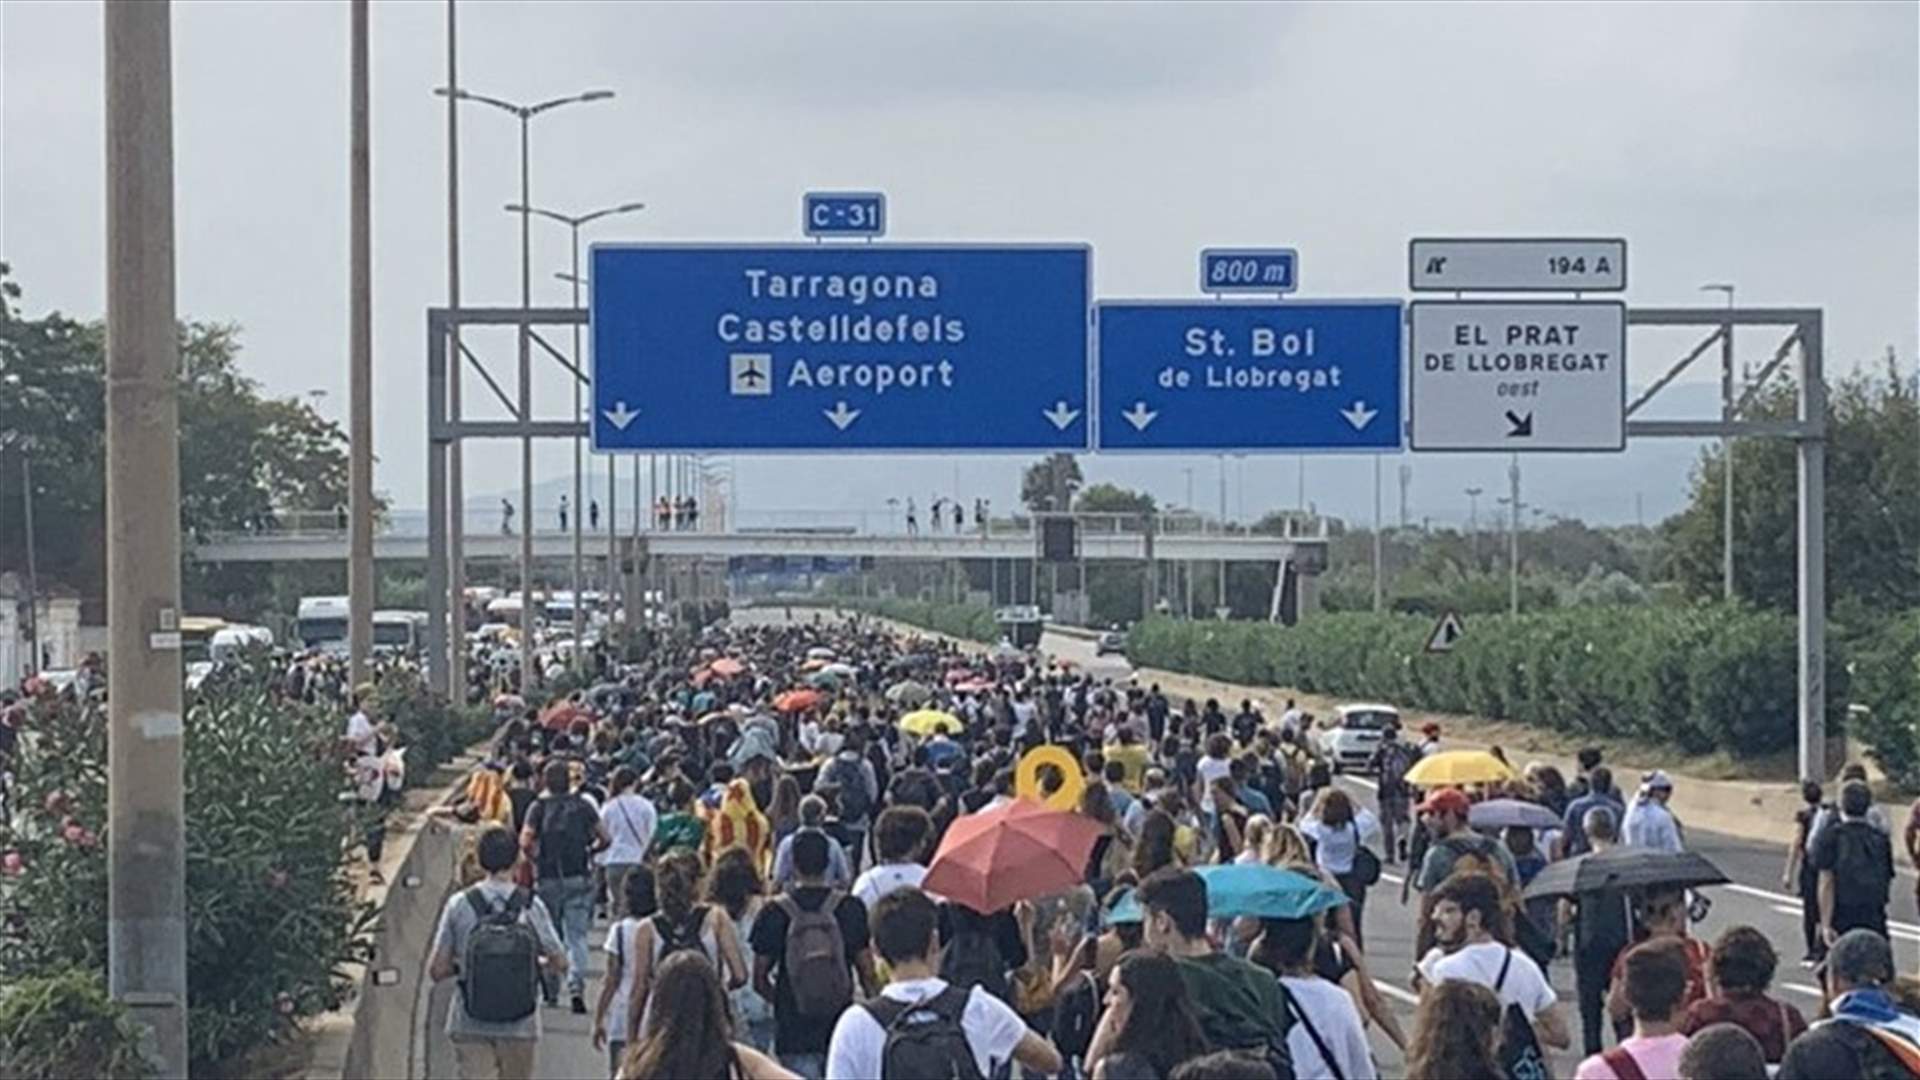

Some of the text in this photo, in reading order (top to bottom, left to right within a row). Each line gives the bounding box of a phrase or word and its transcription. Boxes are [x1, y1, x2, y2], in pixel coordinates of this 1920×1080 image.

[1211, 258, 1285, 281] 800 m
[1548, 256, 1612, 275] 194 A
[745, 269, 938, 304] Tarragona
[717, 313, 966, 343] Castelldefels
[1455, 324, 1580, 346] EL PRAT
[1184, 327, 1236, 356] St.
[1424, 353, 1610, 372] DE LLOBREGAT
[787, 359, 954, 394] Aeroport
[1158, 365, 1341, 393] de Llobregat
[1496, 379, 1540, 398] oest
